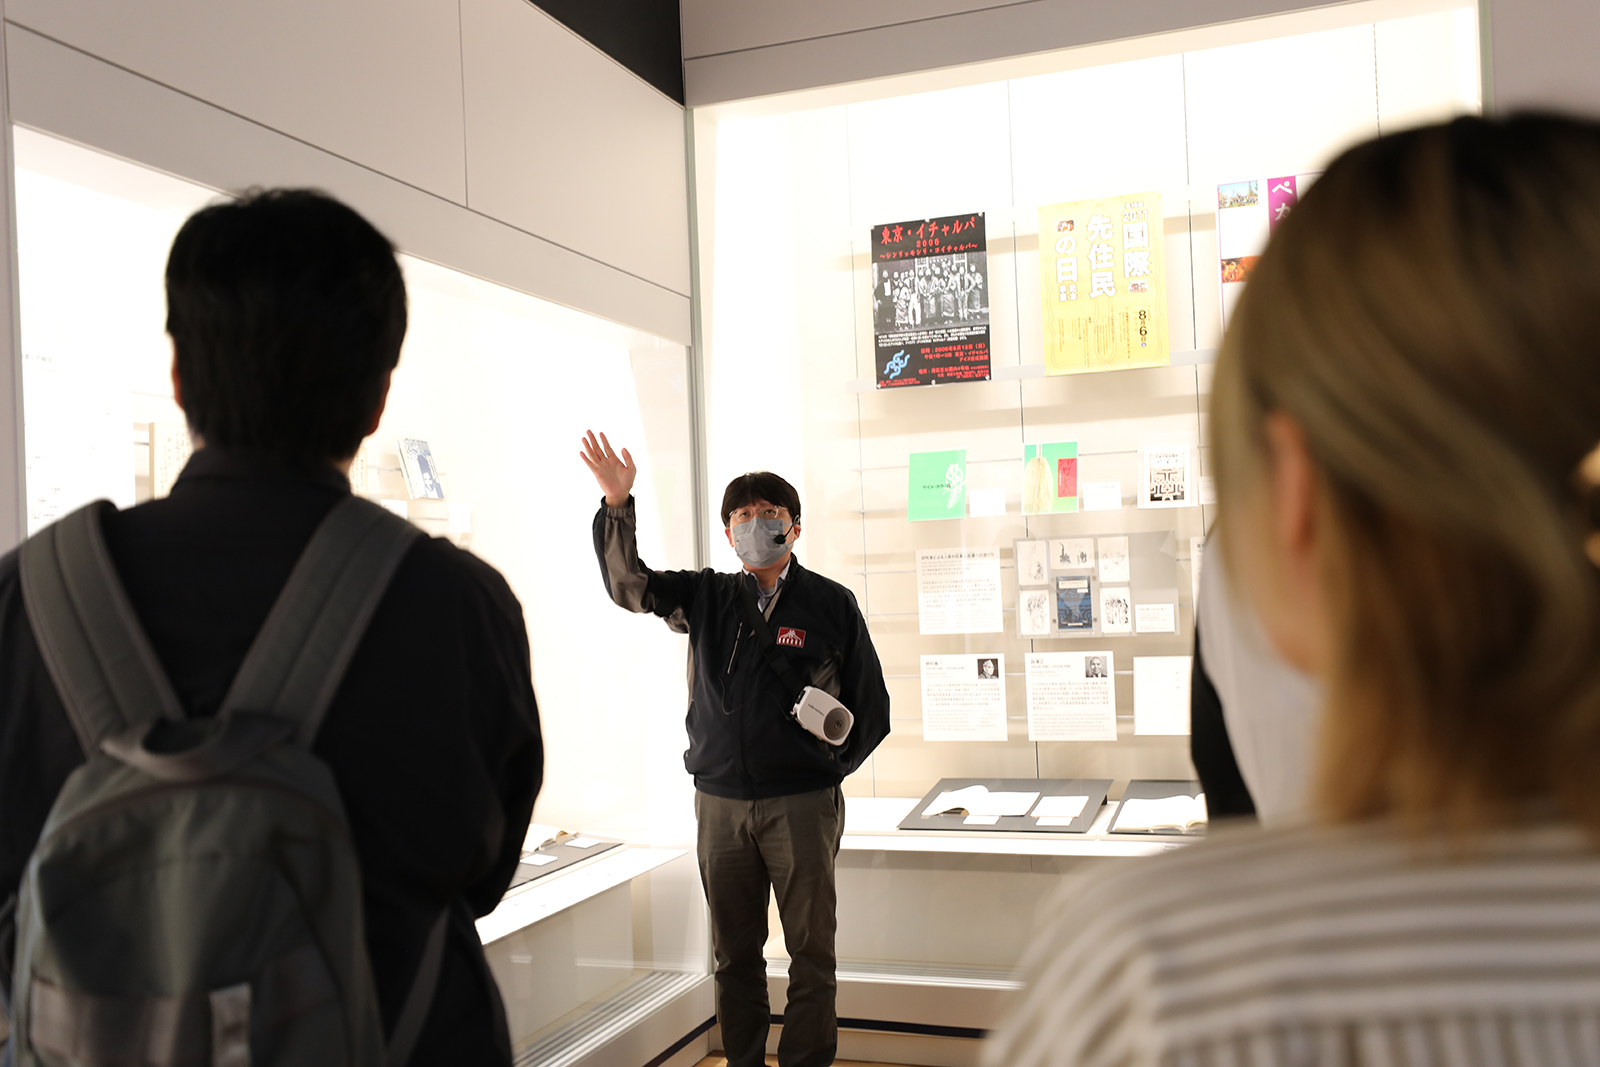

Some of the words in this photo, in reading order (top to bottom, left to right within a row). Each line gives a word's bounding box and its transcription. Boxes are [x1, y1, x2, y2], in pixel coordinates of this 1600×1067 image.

[881, 217, 976, 245] 東京・イチャルパ
[1122, 209, 1148, 222] 2011
[1055, 235, 1079, 284] の日
[1086, 213, 1117, 299] 先住民
[1121, 221, 1152, 280] 国際
